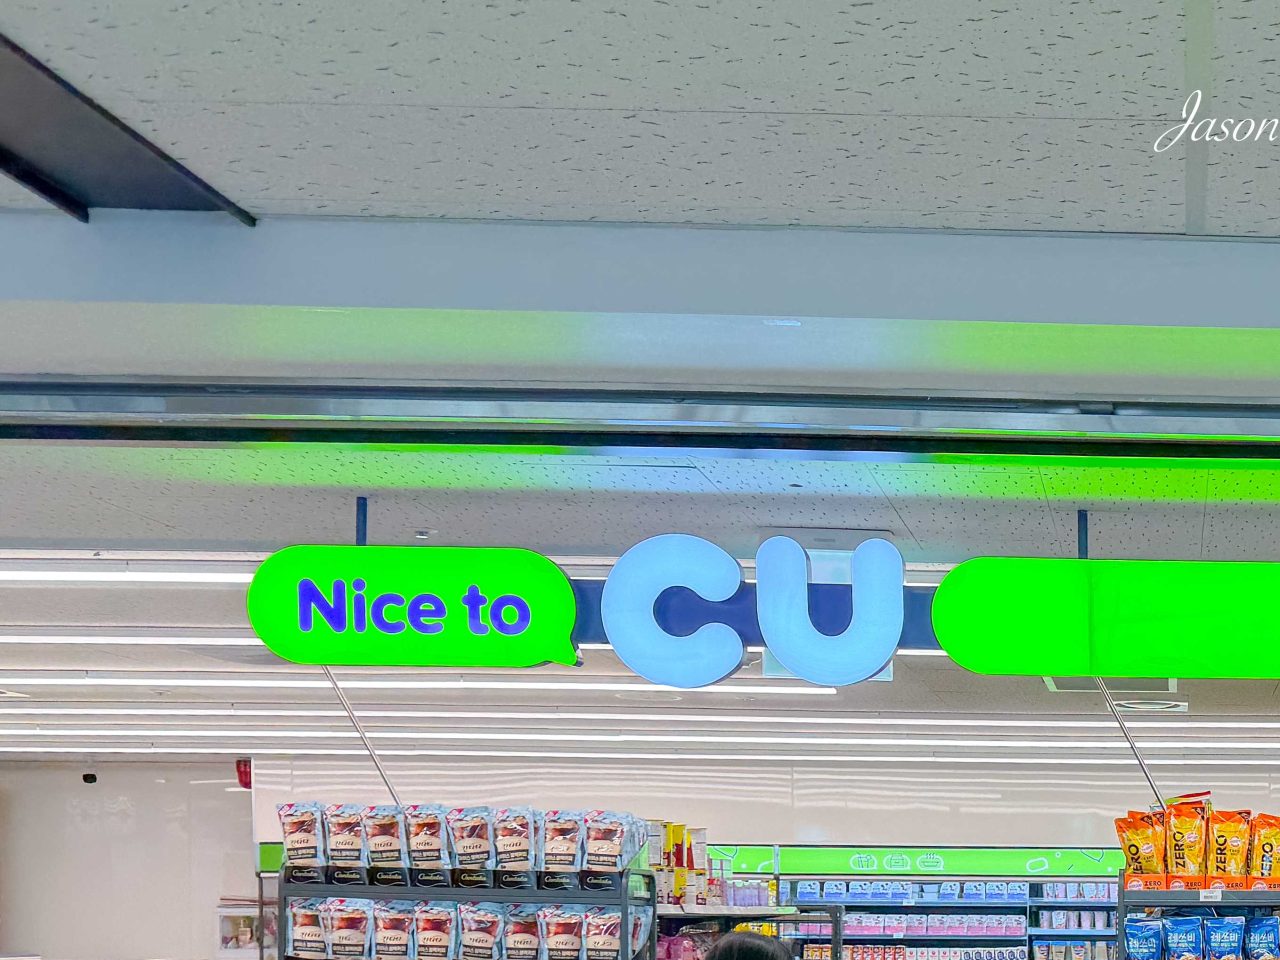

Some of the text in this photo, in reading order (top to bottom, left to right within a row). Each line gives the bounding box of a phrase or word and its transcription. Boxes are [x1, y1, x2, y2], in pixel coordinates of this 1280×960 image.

[298, 578, 531, 635] Nice to
[601, 533, 905, 688] CU
[1216, 835, 1227, 872] ZERO
